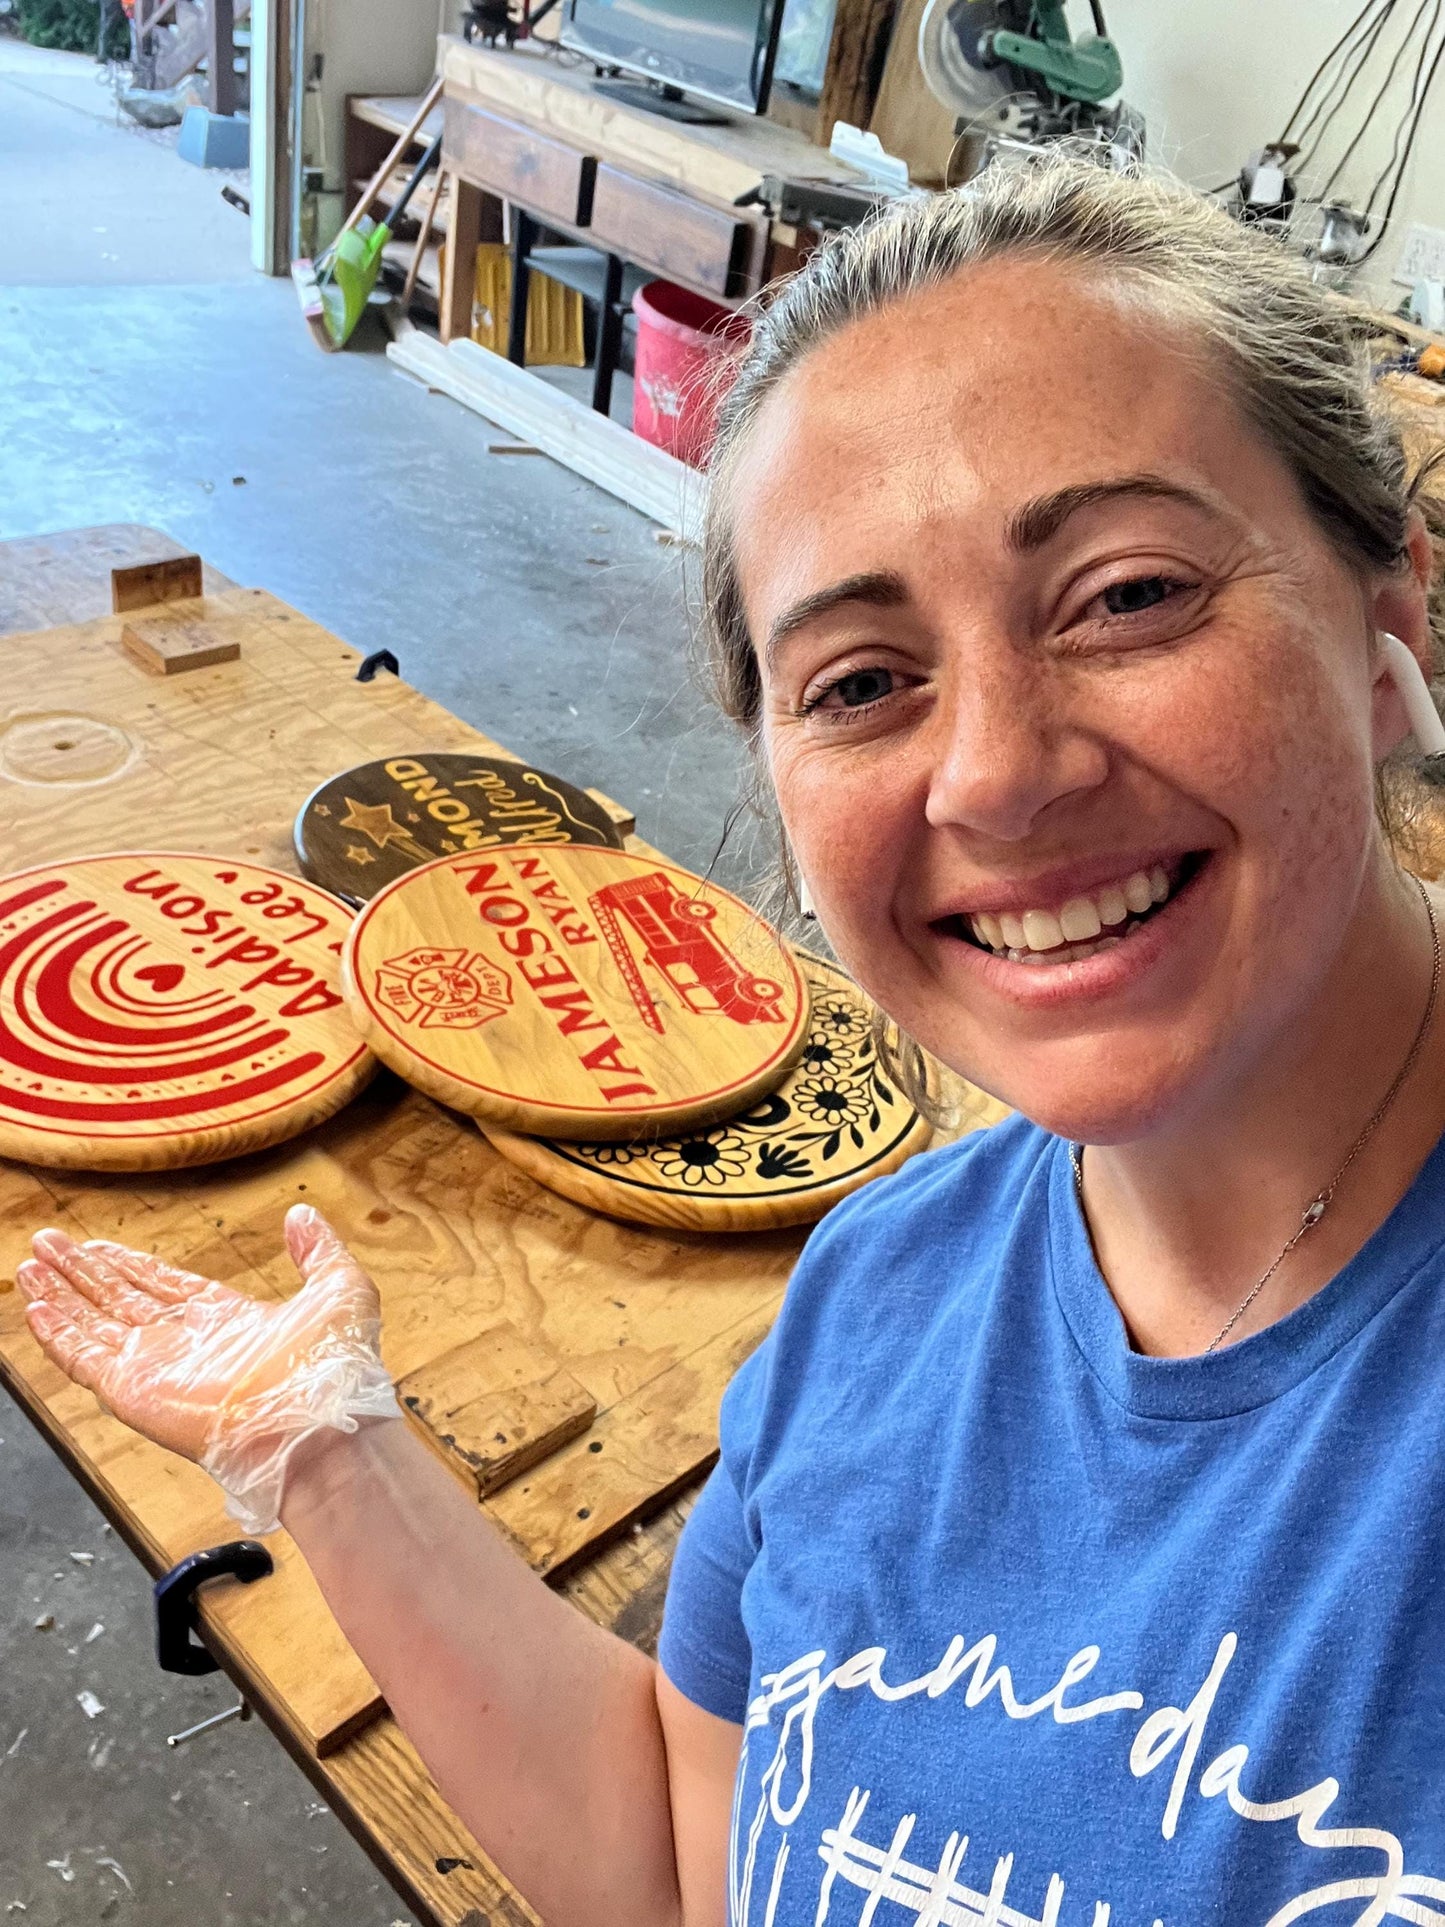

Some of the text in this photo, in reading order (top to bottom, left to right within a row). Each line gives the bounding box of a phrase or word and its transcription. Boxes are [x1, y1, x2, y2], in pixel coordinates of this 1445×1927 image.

[385, 758, 502, 849] MOND
[123, 869, 345, 1019] Addison
[239, 881, 330, 946] Lee
[509, 856, 599, 947] RYAN
[450, 860, 658, 1105] JAMESON
[759, 1631, 1404, 1926] game day
